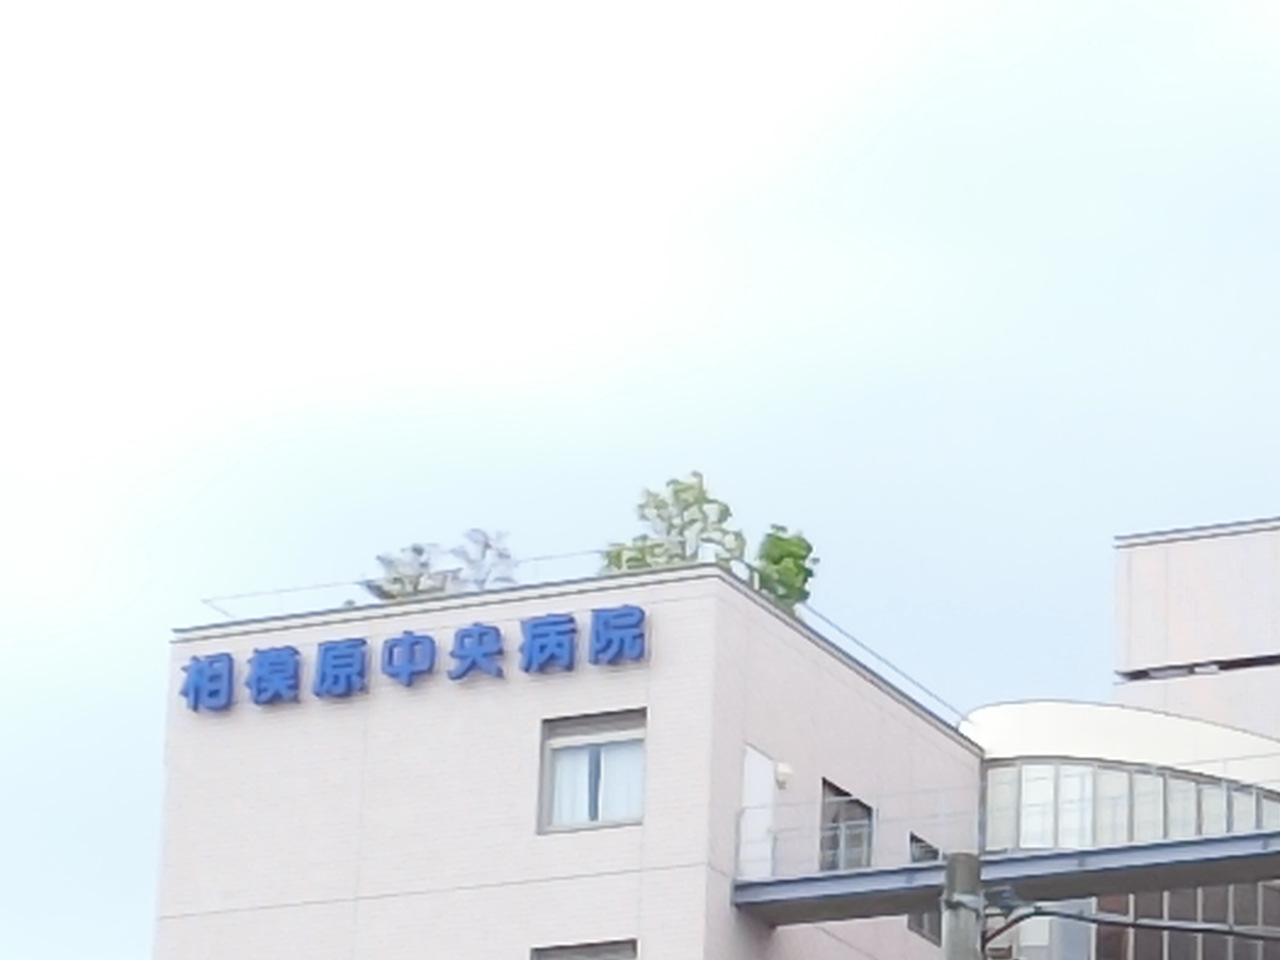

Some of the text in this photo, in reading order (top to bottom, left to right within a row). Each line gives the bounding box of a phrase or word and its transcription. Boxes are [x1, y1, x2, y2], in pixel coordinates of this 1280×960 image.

[181, 605, 647, 711] 相模原中央病院
